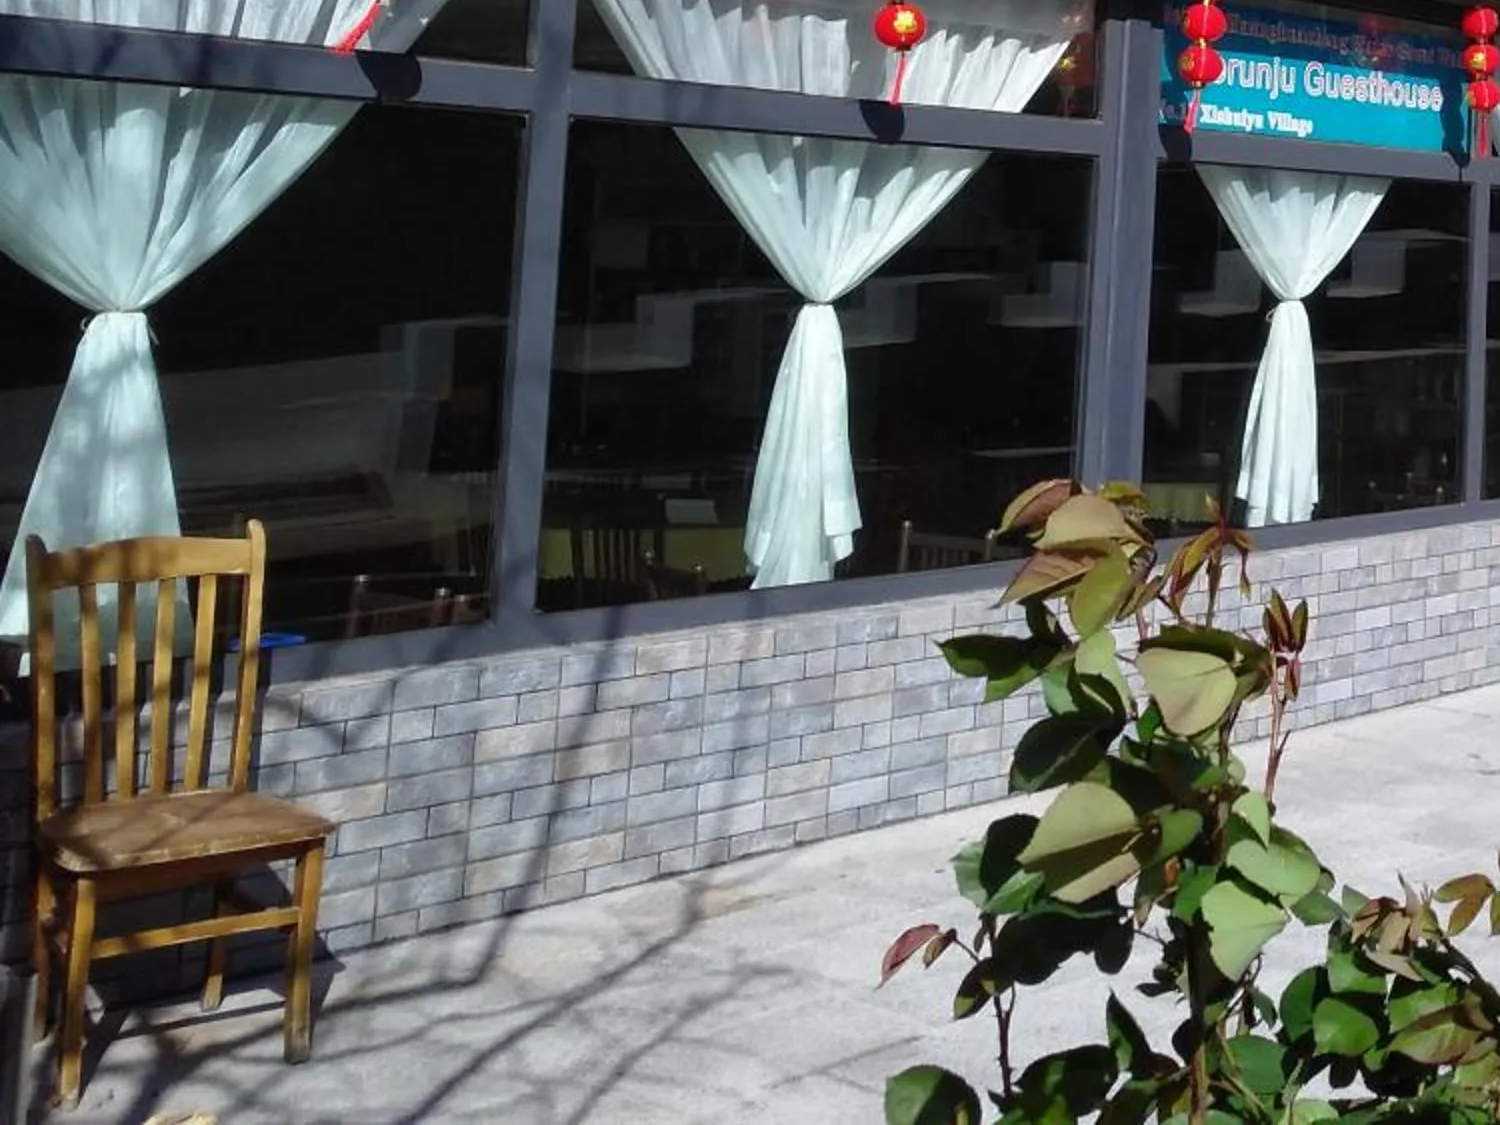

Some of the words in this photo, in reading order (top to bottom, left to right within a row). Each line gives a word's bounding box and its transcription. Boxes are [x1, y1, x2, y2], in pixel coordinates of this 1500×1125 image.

[1209, 55, 1297, 100] runju
[1303, 61, 1443, 112] Guesthouse
[1268, 111, 1313, 137] Village
